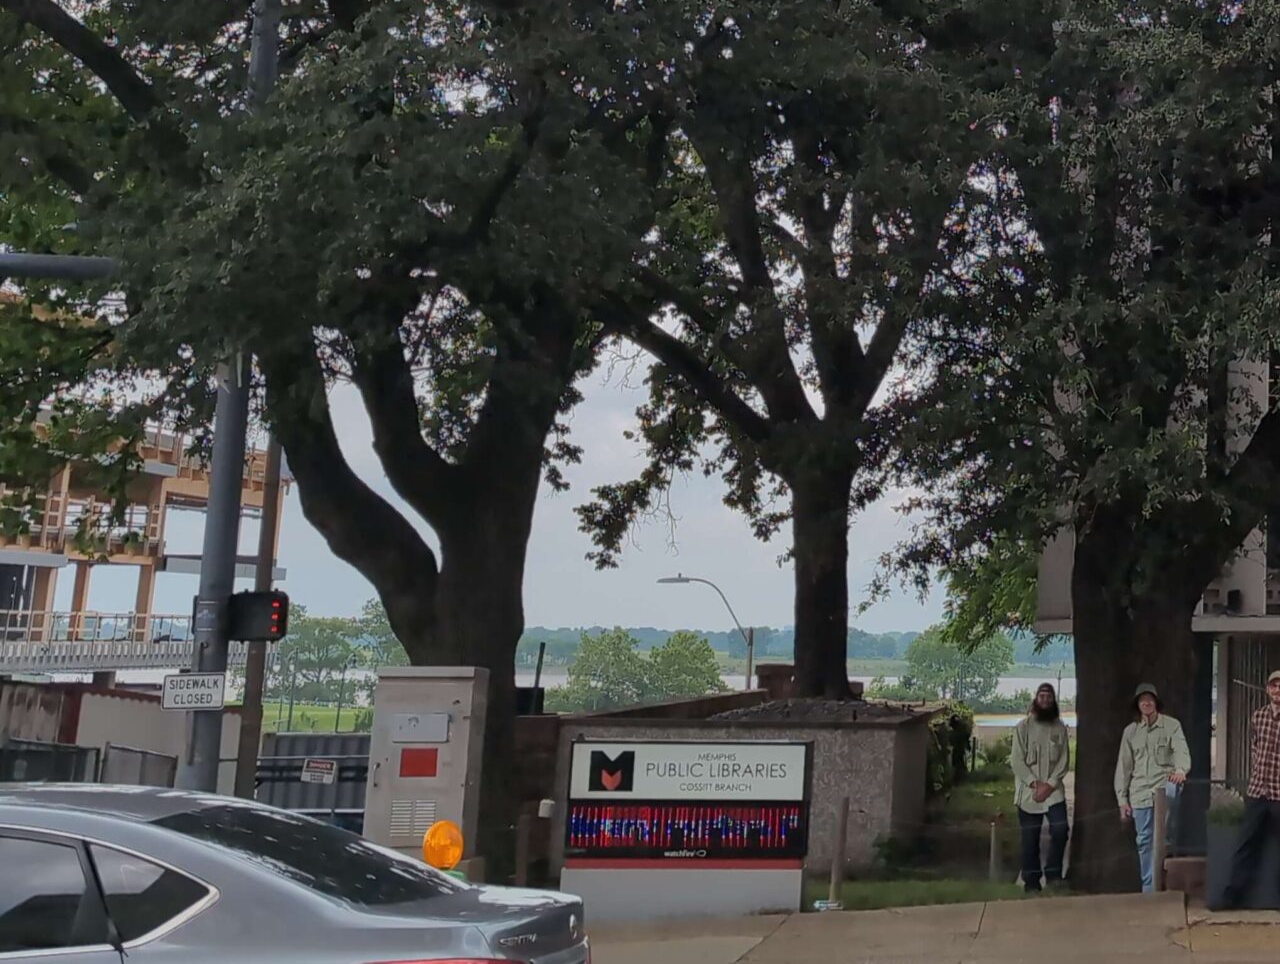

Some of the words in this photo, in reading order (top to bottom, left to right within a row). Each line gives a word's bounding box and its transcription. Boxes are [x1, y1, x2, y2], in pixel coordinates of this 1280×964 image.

[169, 678, 219, 690] SIDEWALK
[173, 693, 213, 705] CLOSED
[698, 753, 736, 762] MEMPHIS
[646, 763, 703, 778] PUBLIC
[709, 763, 787, 778] LIBRARIES
[680, 783, 712, 792] COSSITT
[715, 783, 752, 792] BRANCH
